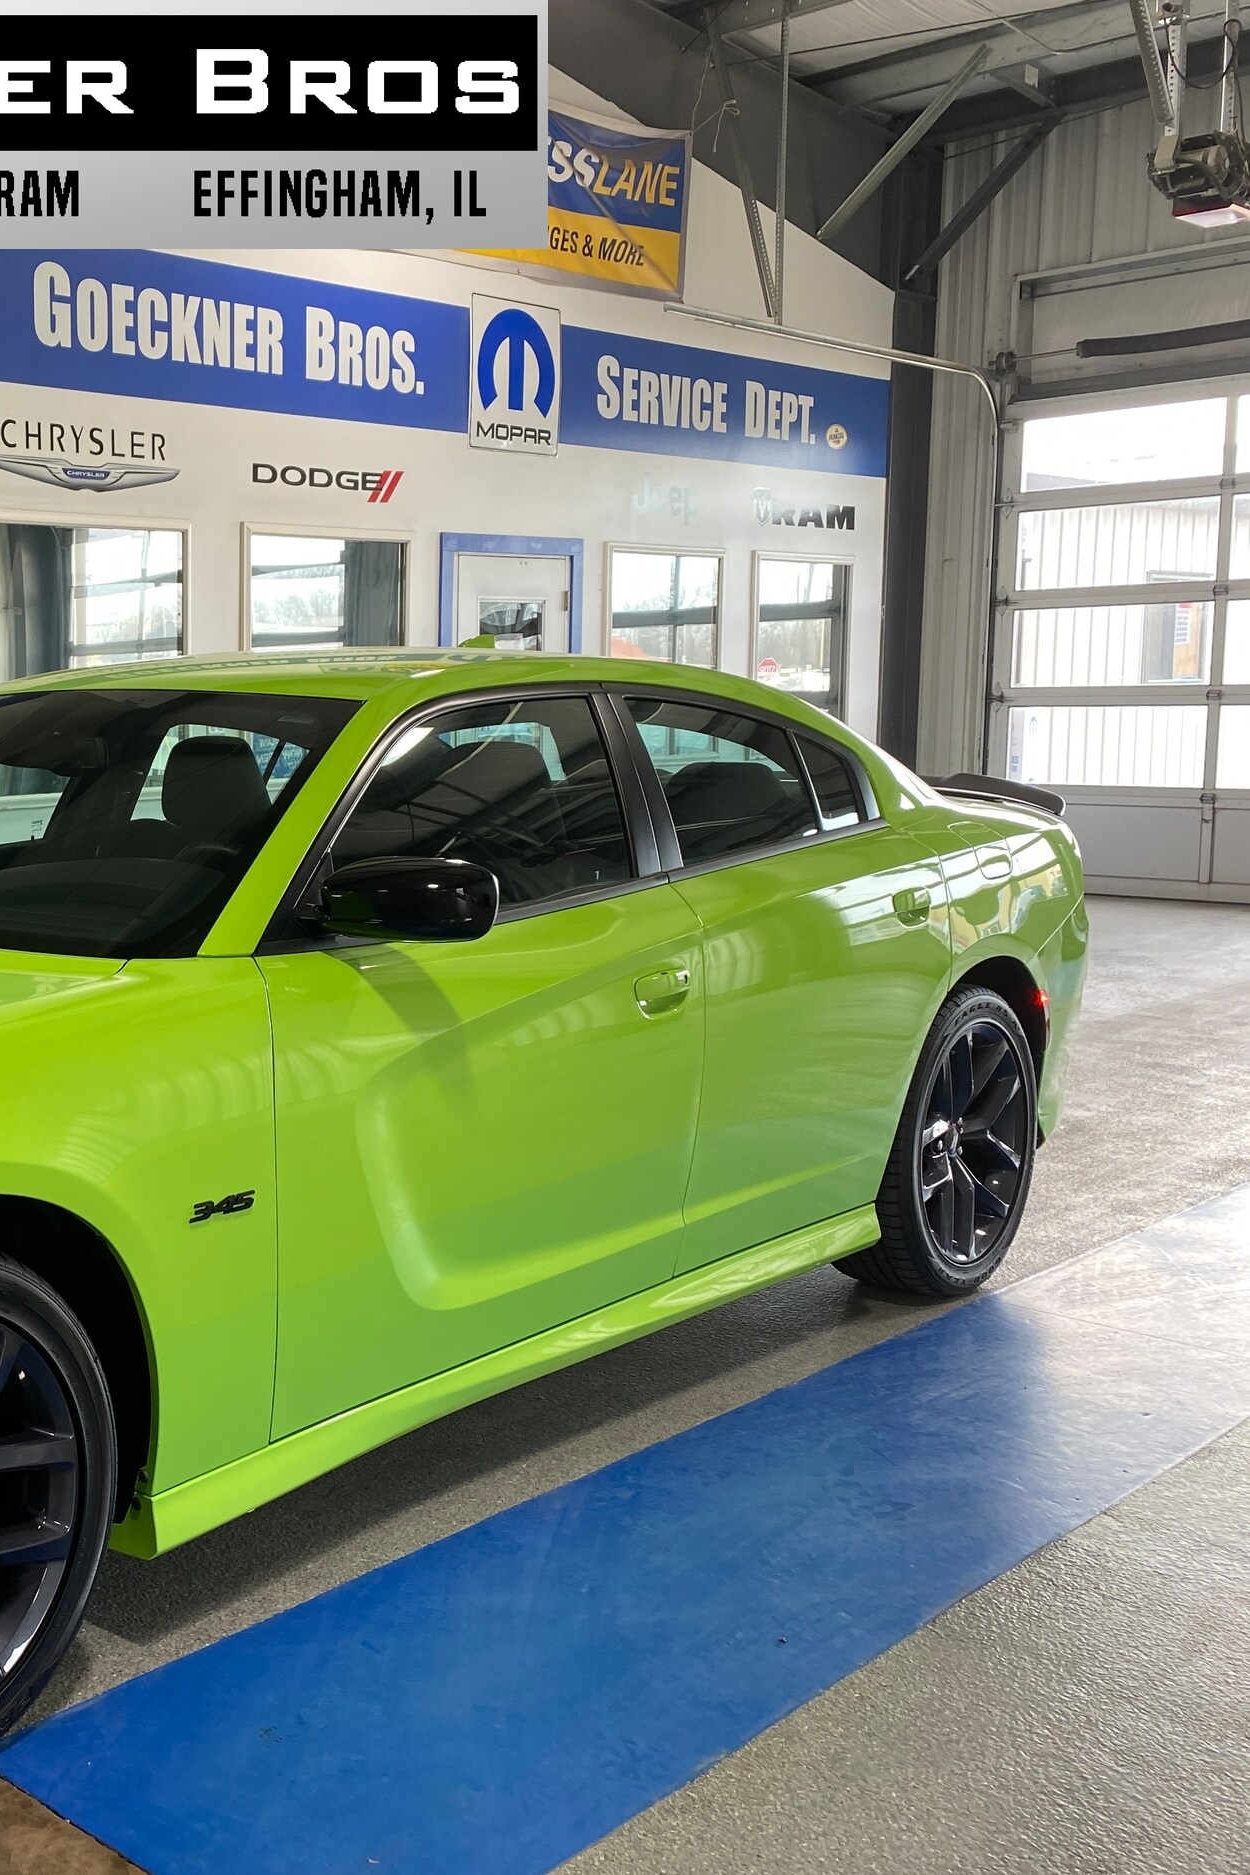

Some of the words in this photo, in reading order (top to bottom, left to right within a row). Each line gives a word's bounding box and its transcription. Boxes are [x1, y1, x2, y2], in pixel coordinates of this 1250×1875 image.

[548, 135, 681, 207] SSLANE
[548, 225, 579, 255] GES
[582, 234, 594, 258] &
[598, 237, 645, 267] MORE
[33, 261, 285, 376] GOECKNER
[306, 306, 426, 396] BROS.
[597, 354, 729, 434] SERVICE
[745, 380, 816, 445] DEPT.
[0, 419, 167, 462] CHRYSLER
[476, 421, 552, 447] MOPAR
[66, 469, 105, 478] CHRYSLER
[252, 462, 384, 492] DODGE
[771, 504, 856, 531] RAM
[189, 1189, 256, 1224] 345
